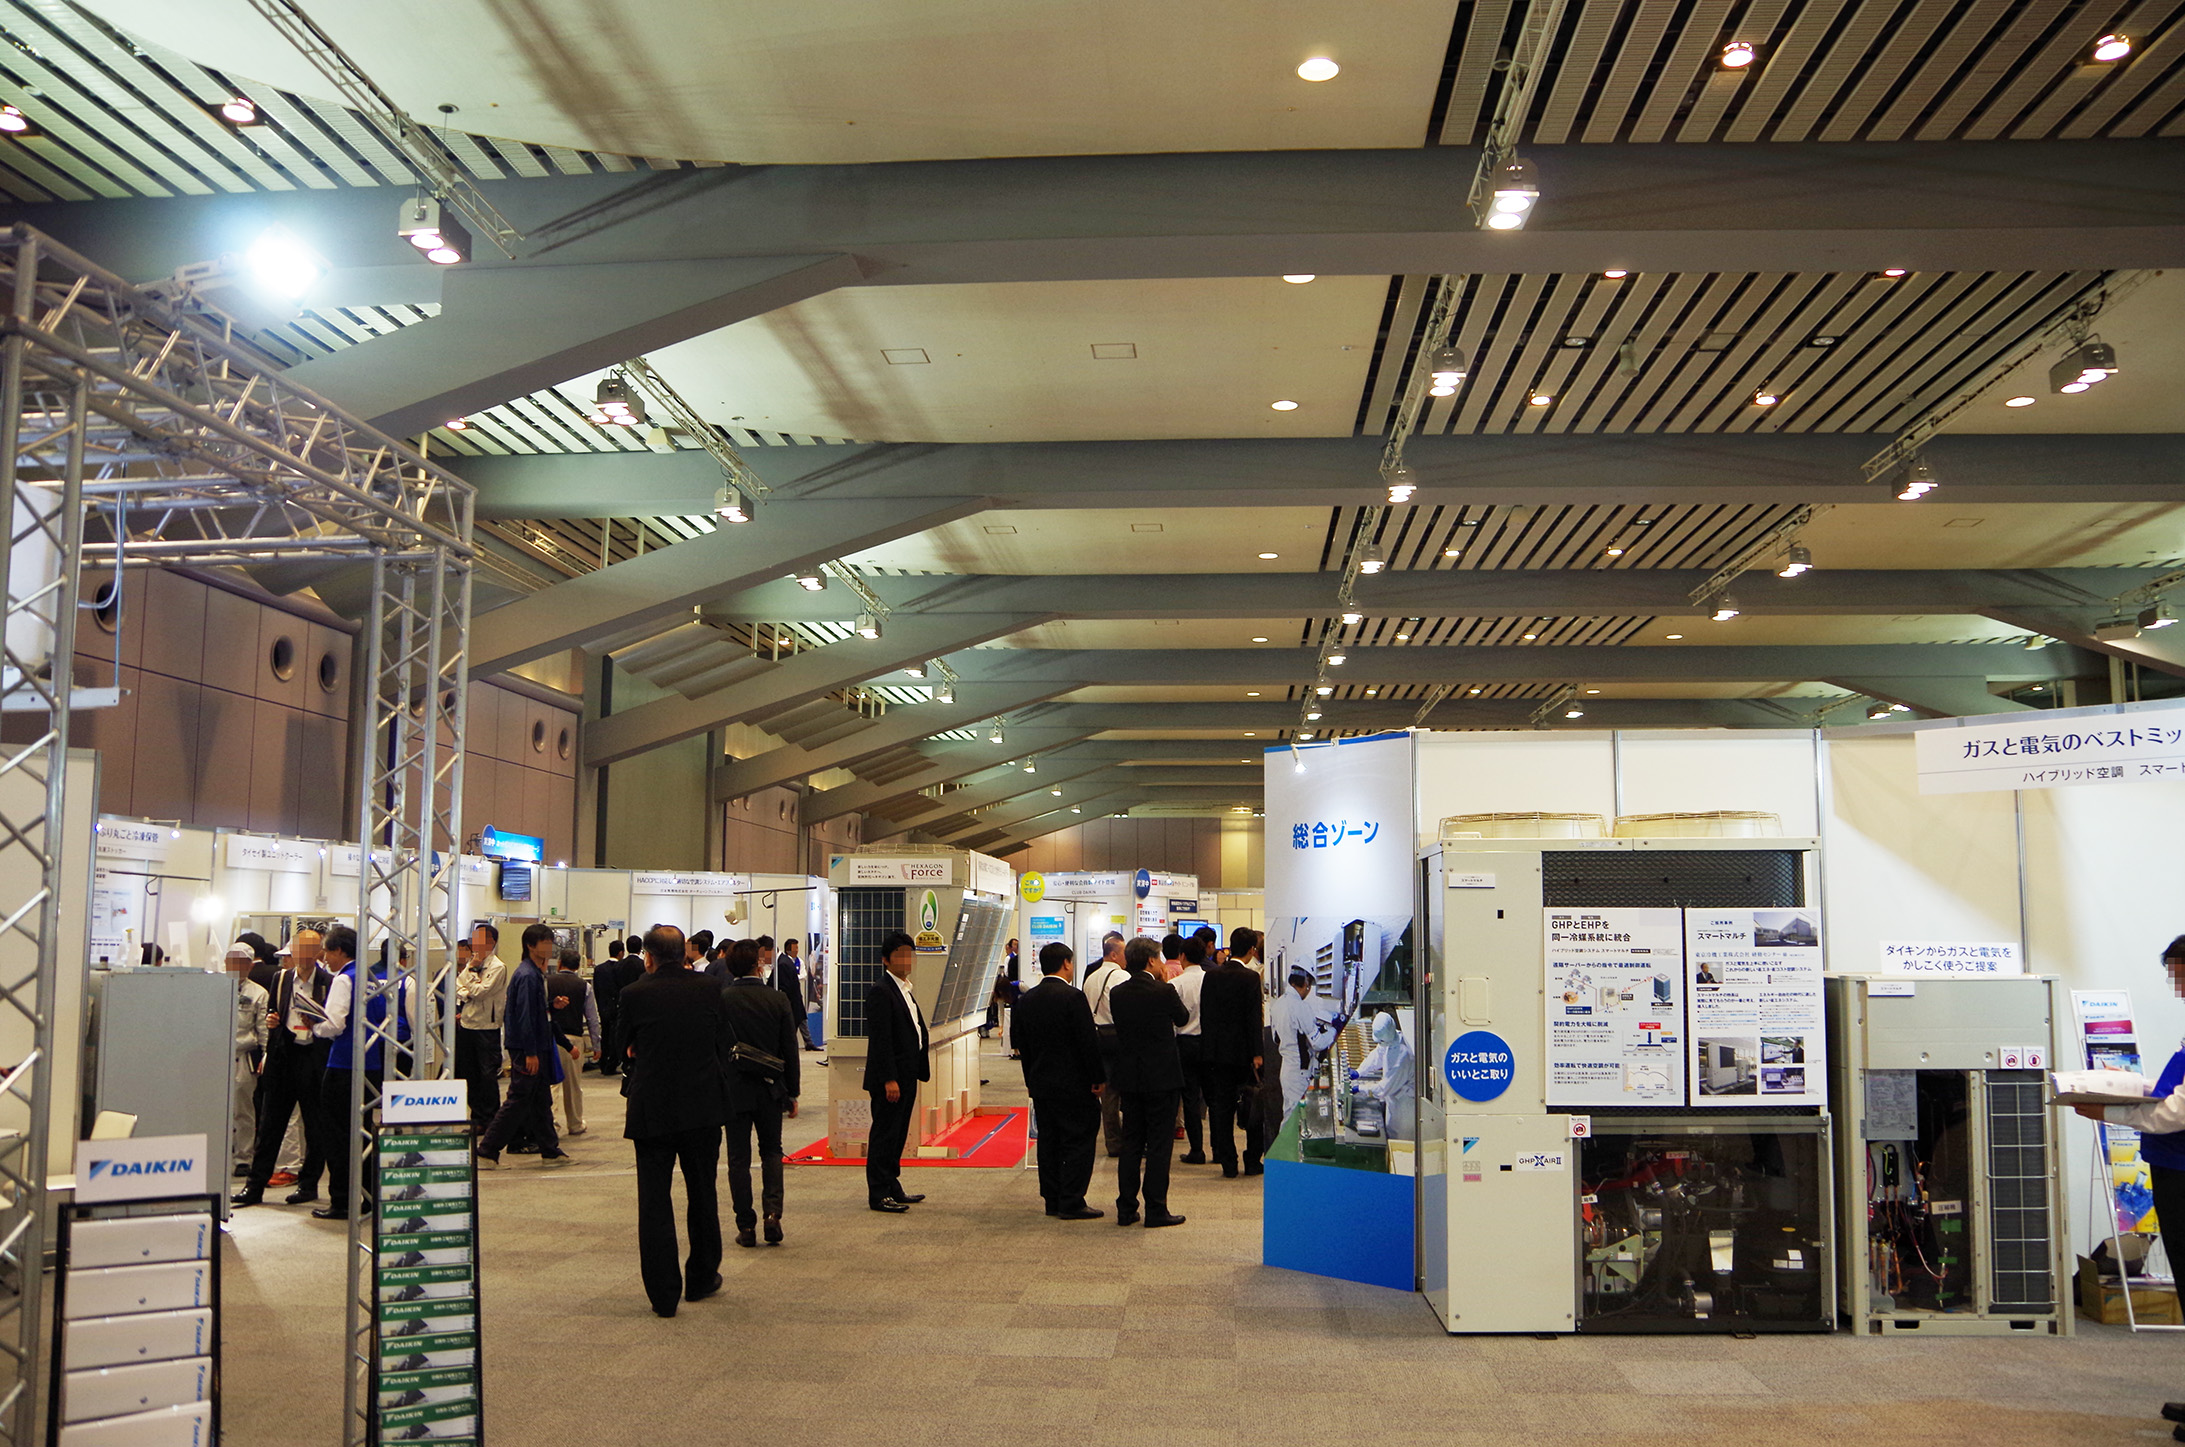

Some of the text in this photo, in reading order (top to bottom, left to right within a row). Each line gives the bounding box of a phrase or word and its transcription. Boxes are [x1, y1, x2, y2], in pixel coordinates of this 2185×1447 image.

[1963, 727, 2182, 759] ガスと電気のベストミッ
[2023, 765, 2124, 783] ハイブリッド空調
[1292, 820, 1379, 849] 総合ゾーン
[911, 869, 943, 880] Force
[1551, 920, 1610, 930] GHPとEHPを
[1551, 933, 1631, 942] 同一冷媒系統に統合
[1697, 932, 1747, 940] スマートマルチ
[1886, 945, 2012, 958] ダイキンからガスと電気を
[1903, 960, 1998, 972] かしこく使うご提案
[1450, 1052, 1508, 1063] ガスと電気の
[1450, 1068, 1508, 1080] いいとこ取り
[404, 1096, 458, 1106] DAIKIN
[110, 1159, 193, 1177] DAIKIN
[393, 1204, 421, 1212] DAIKIN
[391, 1238, 419, 1246] DAIKIN
[393, 1306, 422, 1314] DAIKIN
[393, 1340, 422, 1349] DAIKIN
[390, 1376, 419, 1384] DAIKIN
[393, 1411, 423, 1420] DAIKIN
